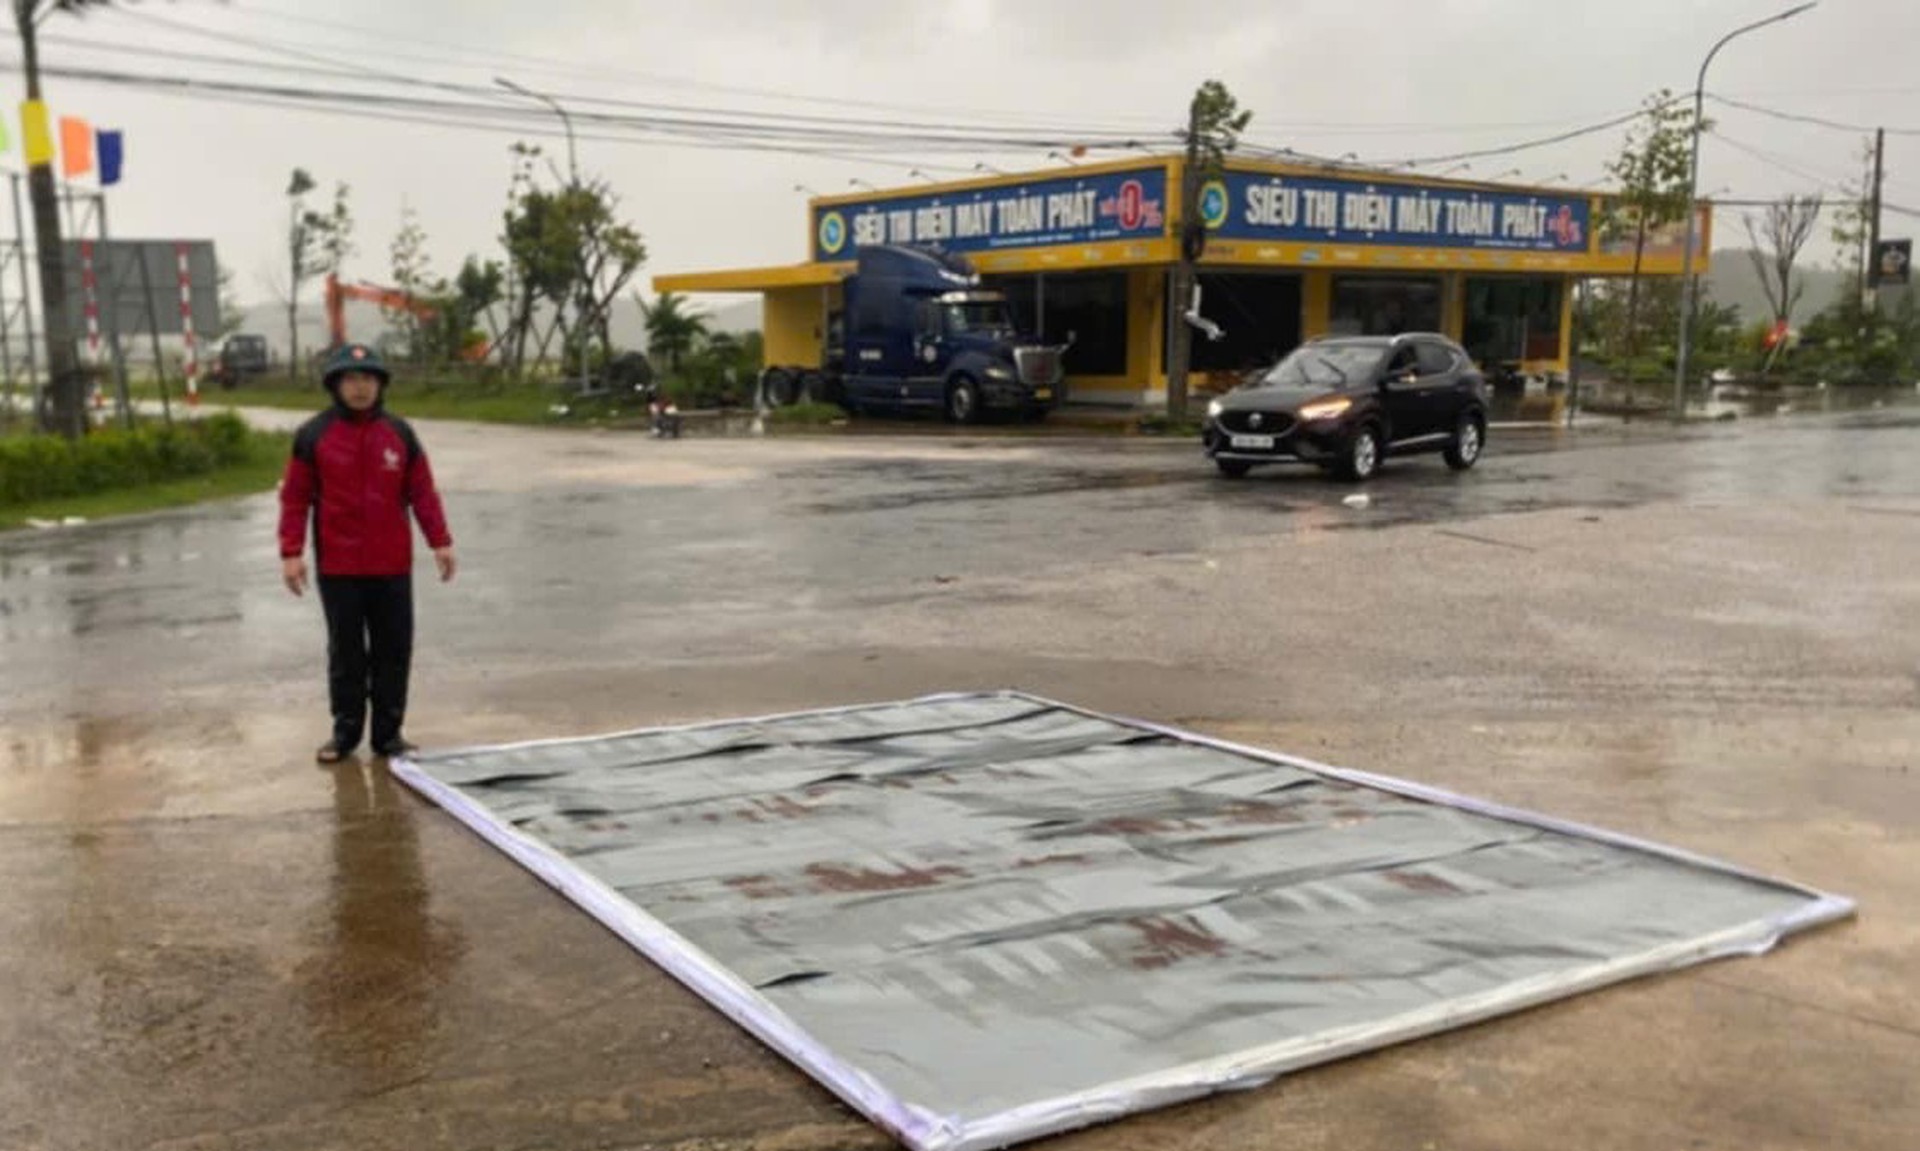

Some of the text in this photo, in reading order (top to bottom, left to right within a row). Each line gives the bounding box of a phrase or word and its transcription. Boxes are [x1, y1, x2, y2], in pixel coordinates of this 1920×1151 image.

[955, 193, 993, 238] MÁY
[997, 188, 1043, 234] TOÀN
[1048, 181, 1097, 230] PHÁT
[1246, 178, 1298, 226] SIÊU
[1303, 189, 1338, 236] THỊ
[1344, 186, 1392, 238] ĐIỆN
[1397, 190, 1441, 233] MÁY
[1445, 193, 1494, 236] TOÀN
[1502, 198, 1547, 238] PHÁT
